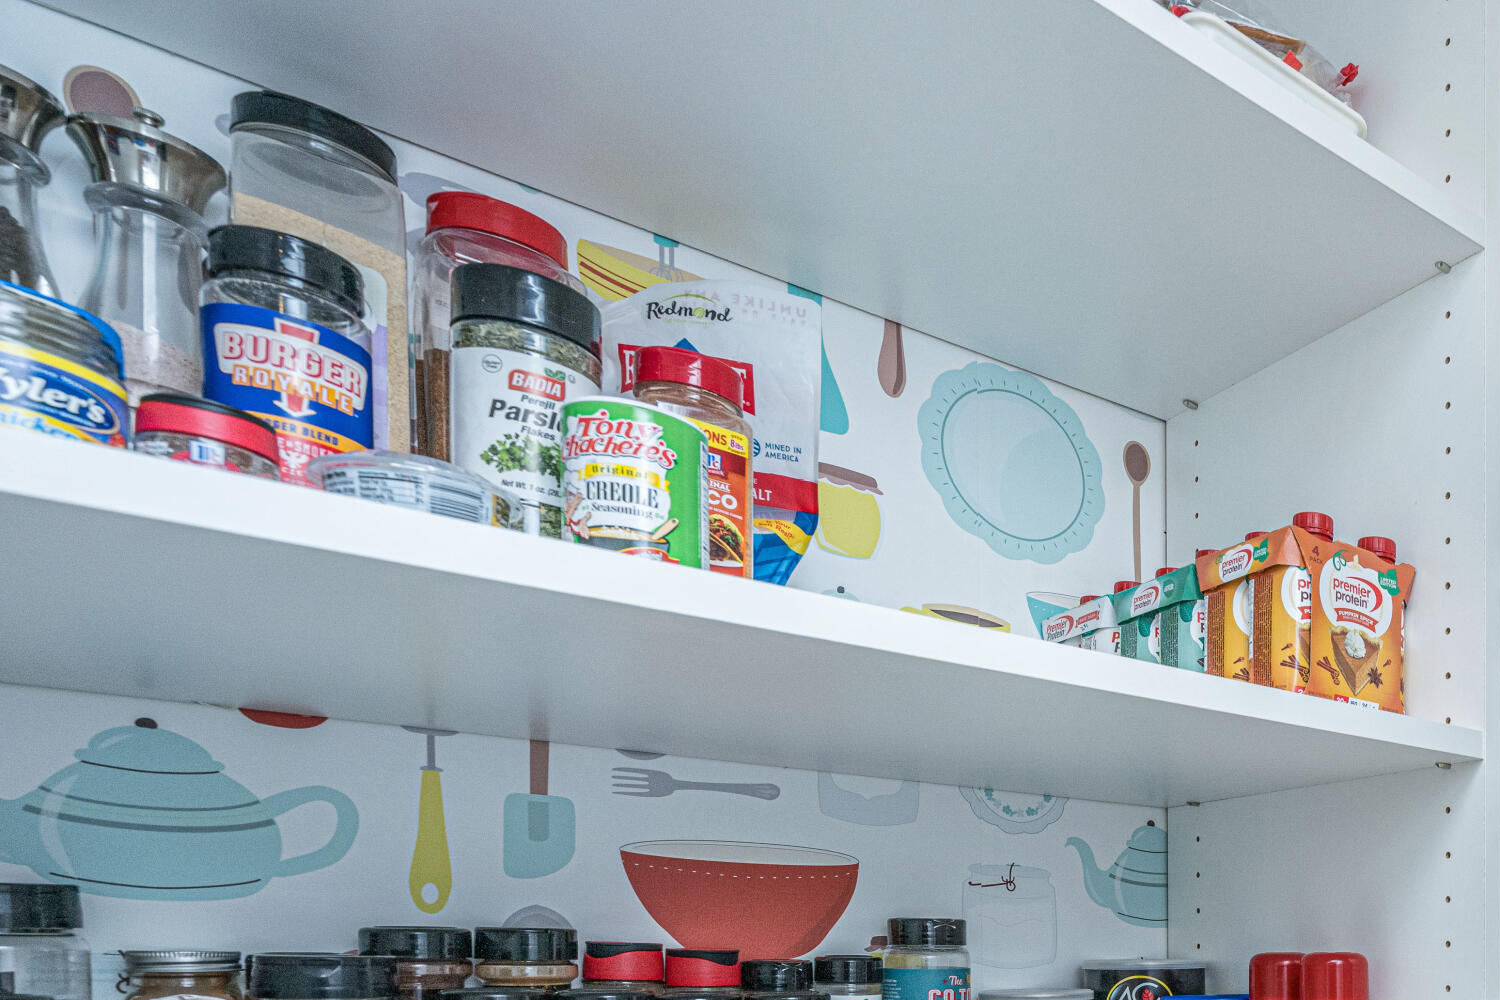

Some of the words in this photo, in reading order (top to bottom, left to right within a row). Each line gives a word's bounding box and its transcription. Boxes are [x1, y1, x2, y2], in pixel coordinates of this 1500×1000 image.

[646, 301, 733, 323] Redmond
[223, 331, 361, 397] BURGER
[233, 366, 355, 414] ROYALE
[512, 372, 562, 397] BADIA
[577, 413, 663, 441] Tony
[765, 442, 790, 453] MINED
[765, 451, 799, 463] AMERICA
[586, 481, 659, 508] CREOLE
[592, 503, 653, 520] Seasoning
[1221, 555, 1246, 569] premier
[1222, 564, 1244, 577] protein
[1333, 577, 1371, 598] premier
[1335, 591, 1368, 608] protein
